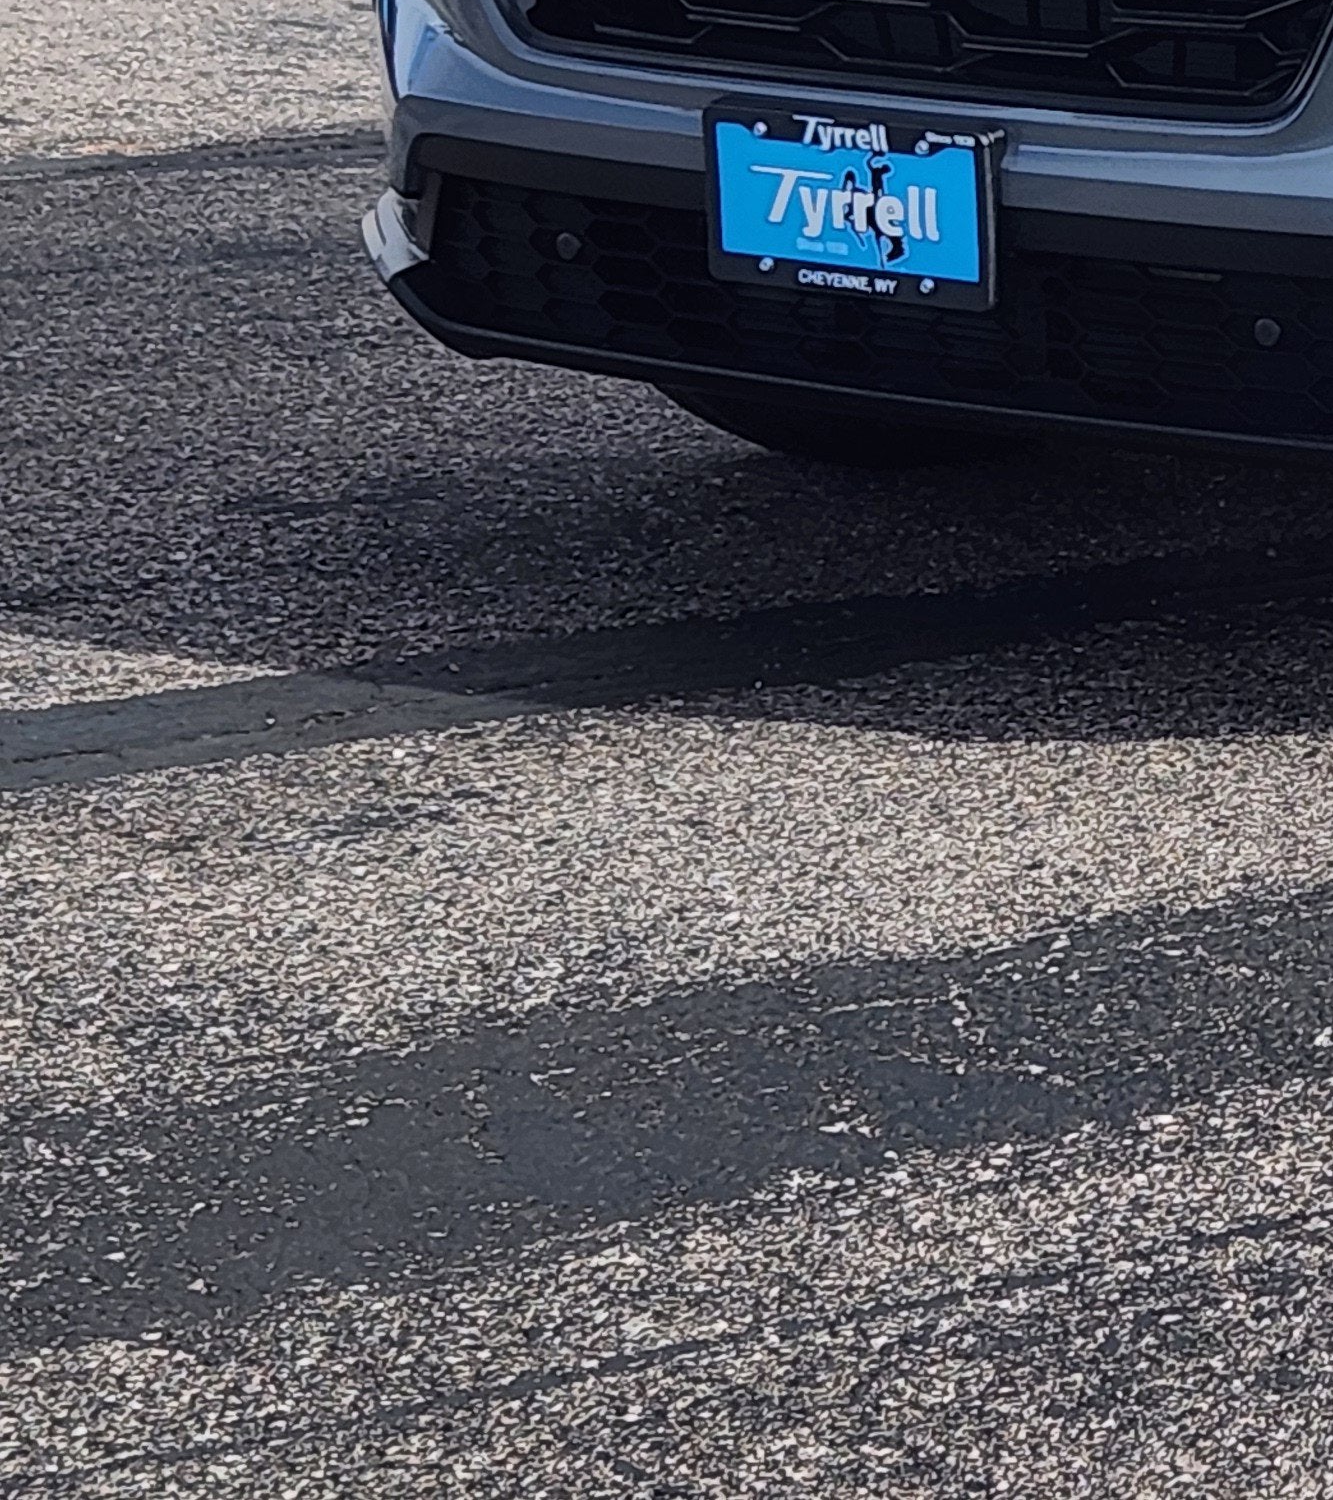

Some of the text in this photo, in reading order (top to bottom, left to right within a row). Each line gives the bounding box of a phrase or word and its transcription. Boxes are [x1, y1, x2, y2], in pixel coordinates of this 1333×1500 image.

[791, 114, 889, 152] Tyrrell
[750, 164, 940, 242] Tyrrell
[874, 275, 898, 295] WY
